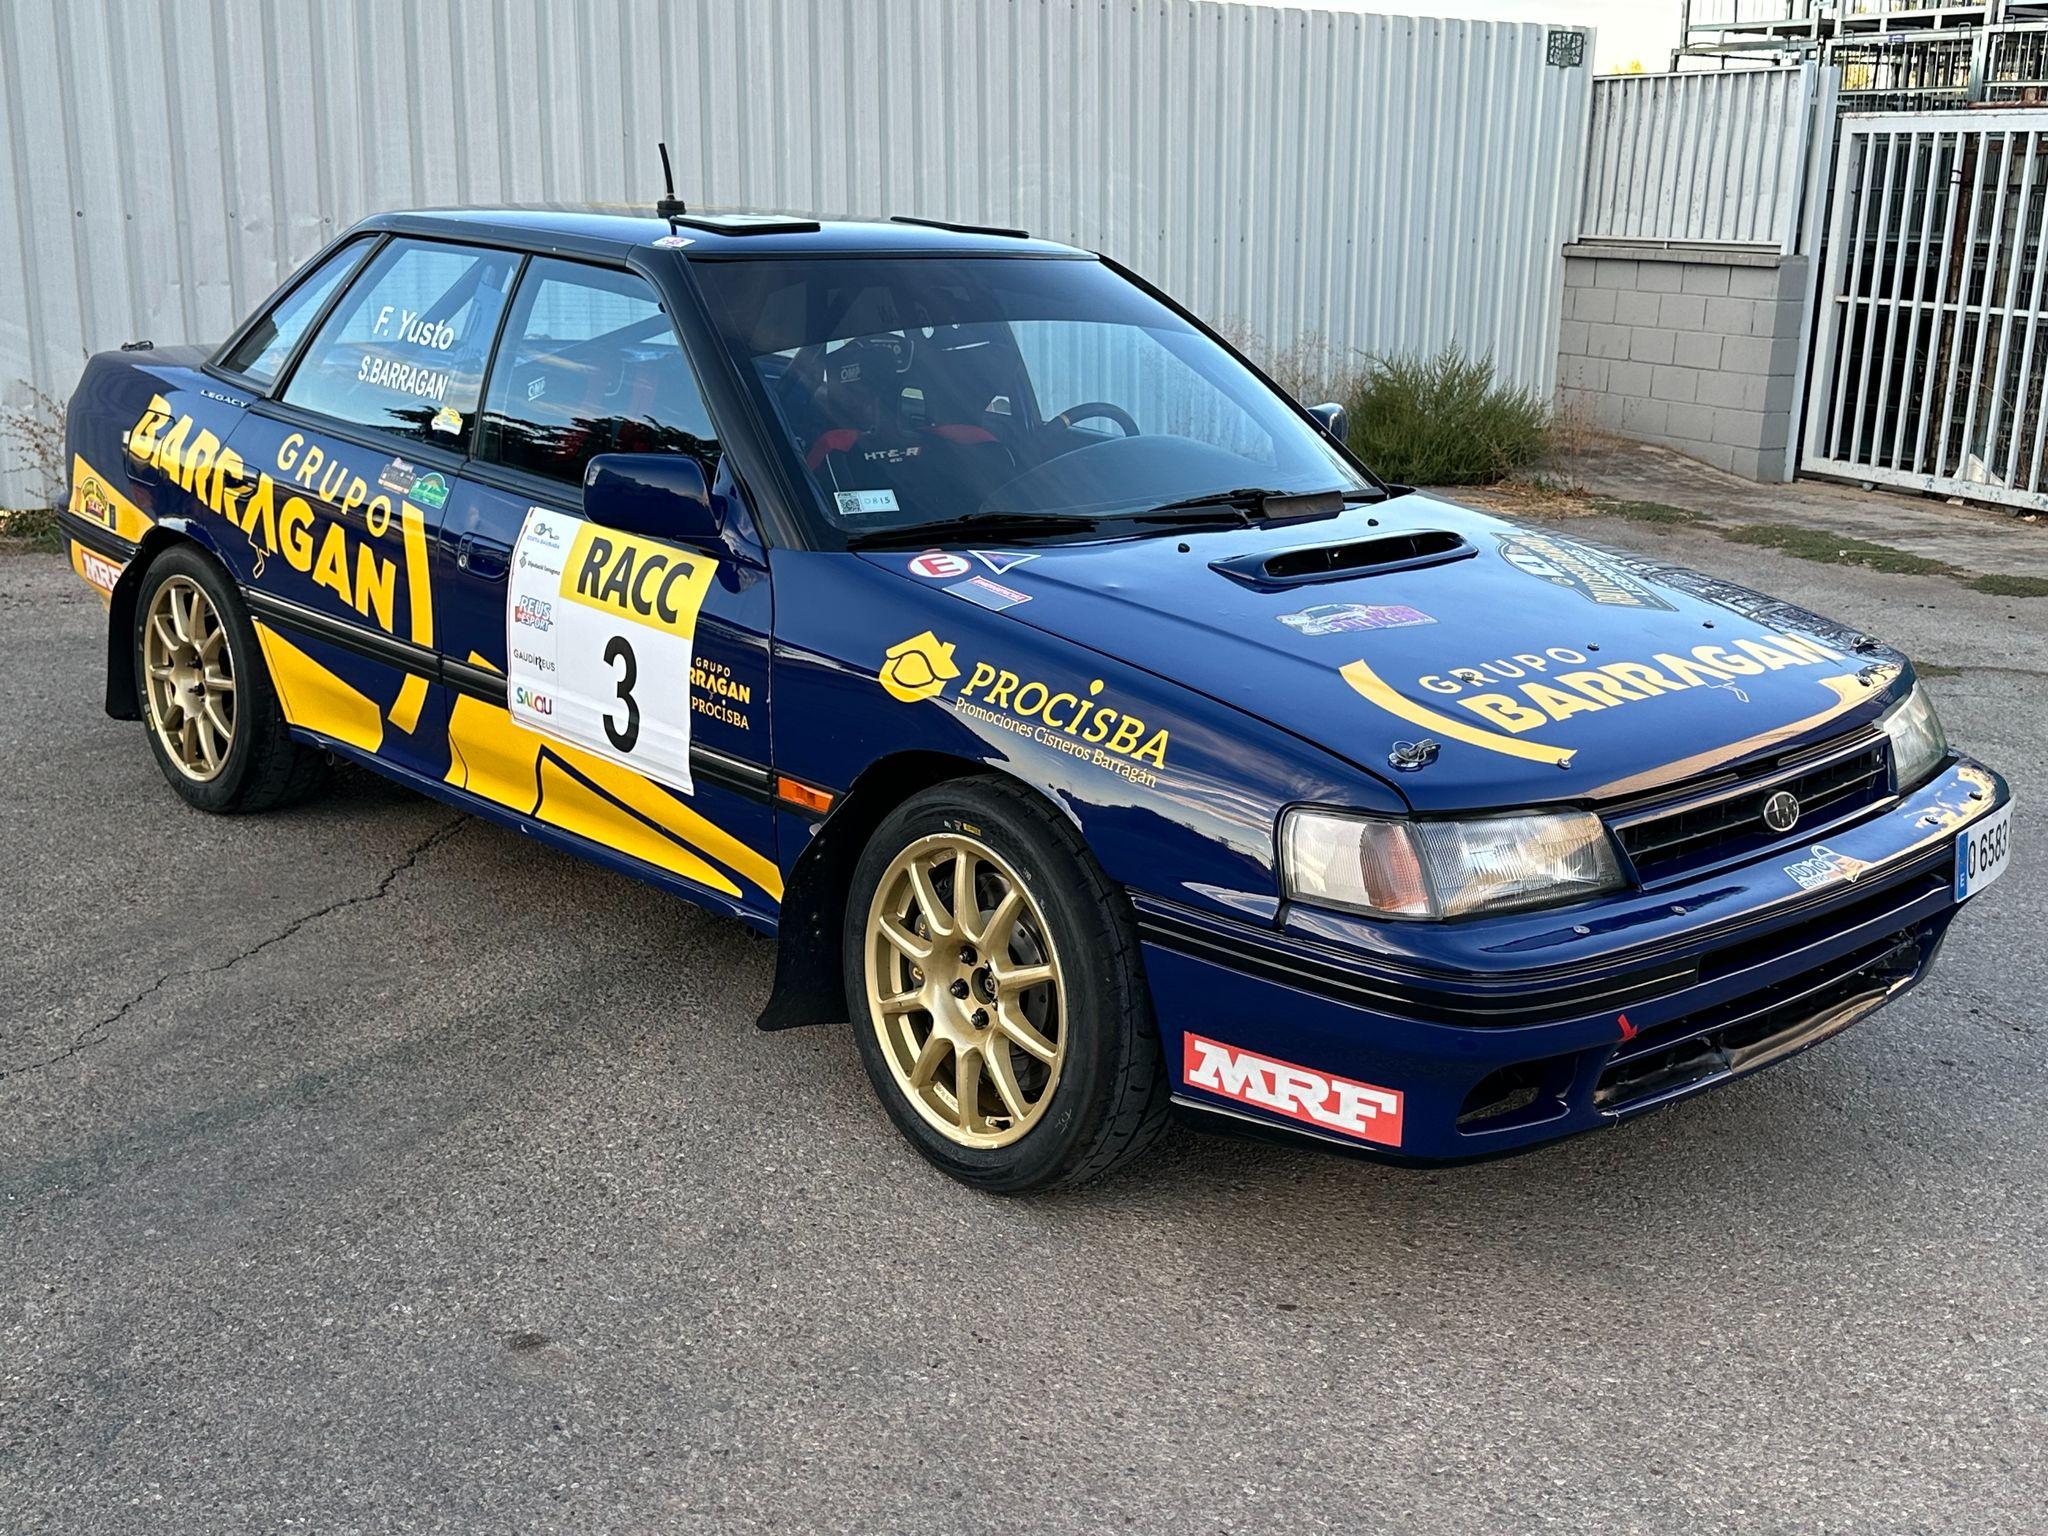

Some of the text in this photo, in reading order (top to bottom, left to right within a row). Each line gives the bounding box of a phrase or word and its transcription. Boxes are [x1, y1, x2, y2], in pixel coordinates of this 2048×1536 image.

[373, 306, 455, 350] F. Yusto
[200, 389, 248, 408] LEGACY
[358, 355, 449, 401] S.BARRAGAN
[277, 432, 392, 539] GRUPO
[127, 393, 397, 633] BARRAGAN
[577, 536, 695, 625] RACC
[918, 556, 961, 576] E
[520, 595, 551, 619] REUS
[521, 612, 550, 632] ESPORT
[690, 666, 751, 704] RRAGAN
[695, 657, 731, 677] GRUPO
[1419, 646, 1588, 695] GRUPO
[1457, 632, 1847, 734] BARRAGAN
[516, 686, 552, 715] SALOU
[603, 635, 641, 753] 3
[954, 696, 1157, 788] Promociones Cisneros Barragán
[1980, 819, 2008, 869] 6583
[1189, 1040, 1398, 1133] MRF
